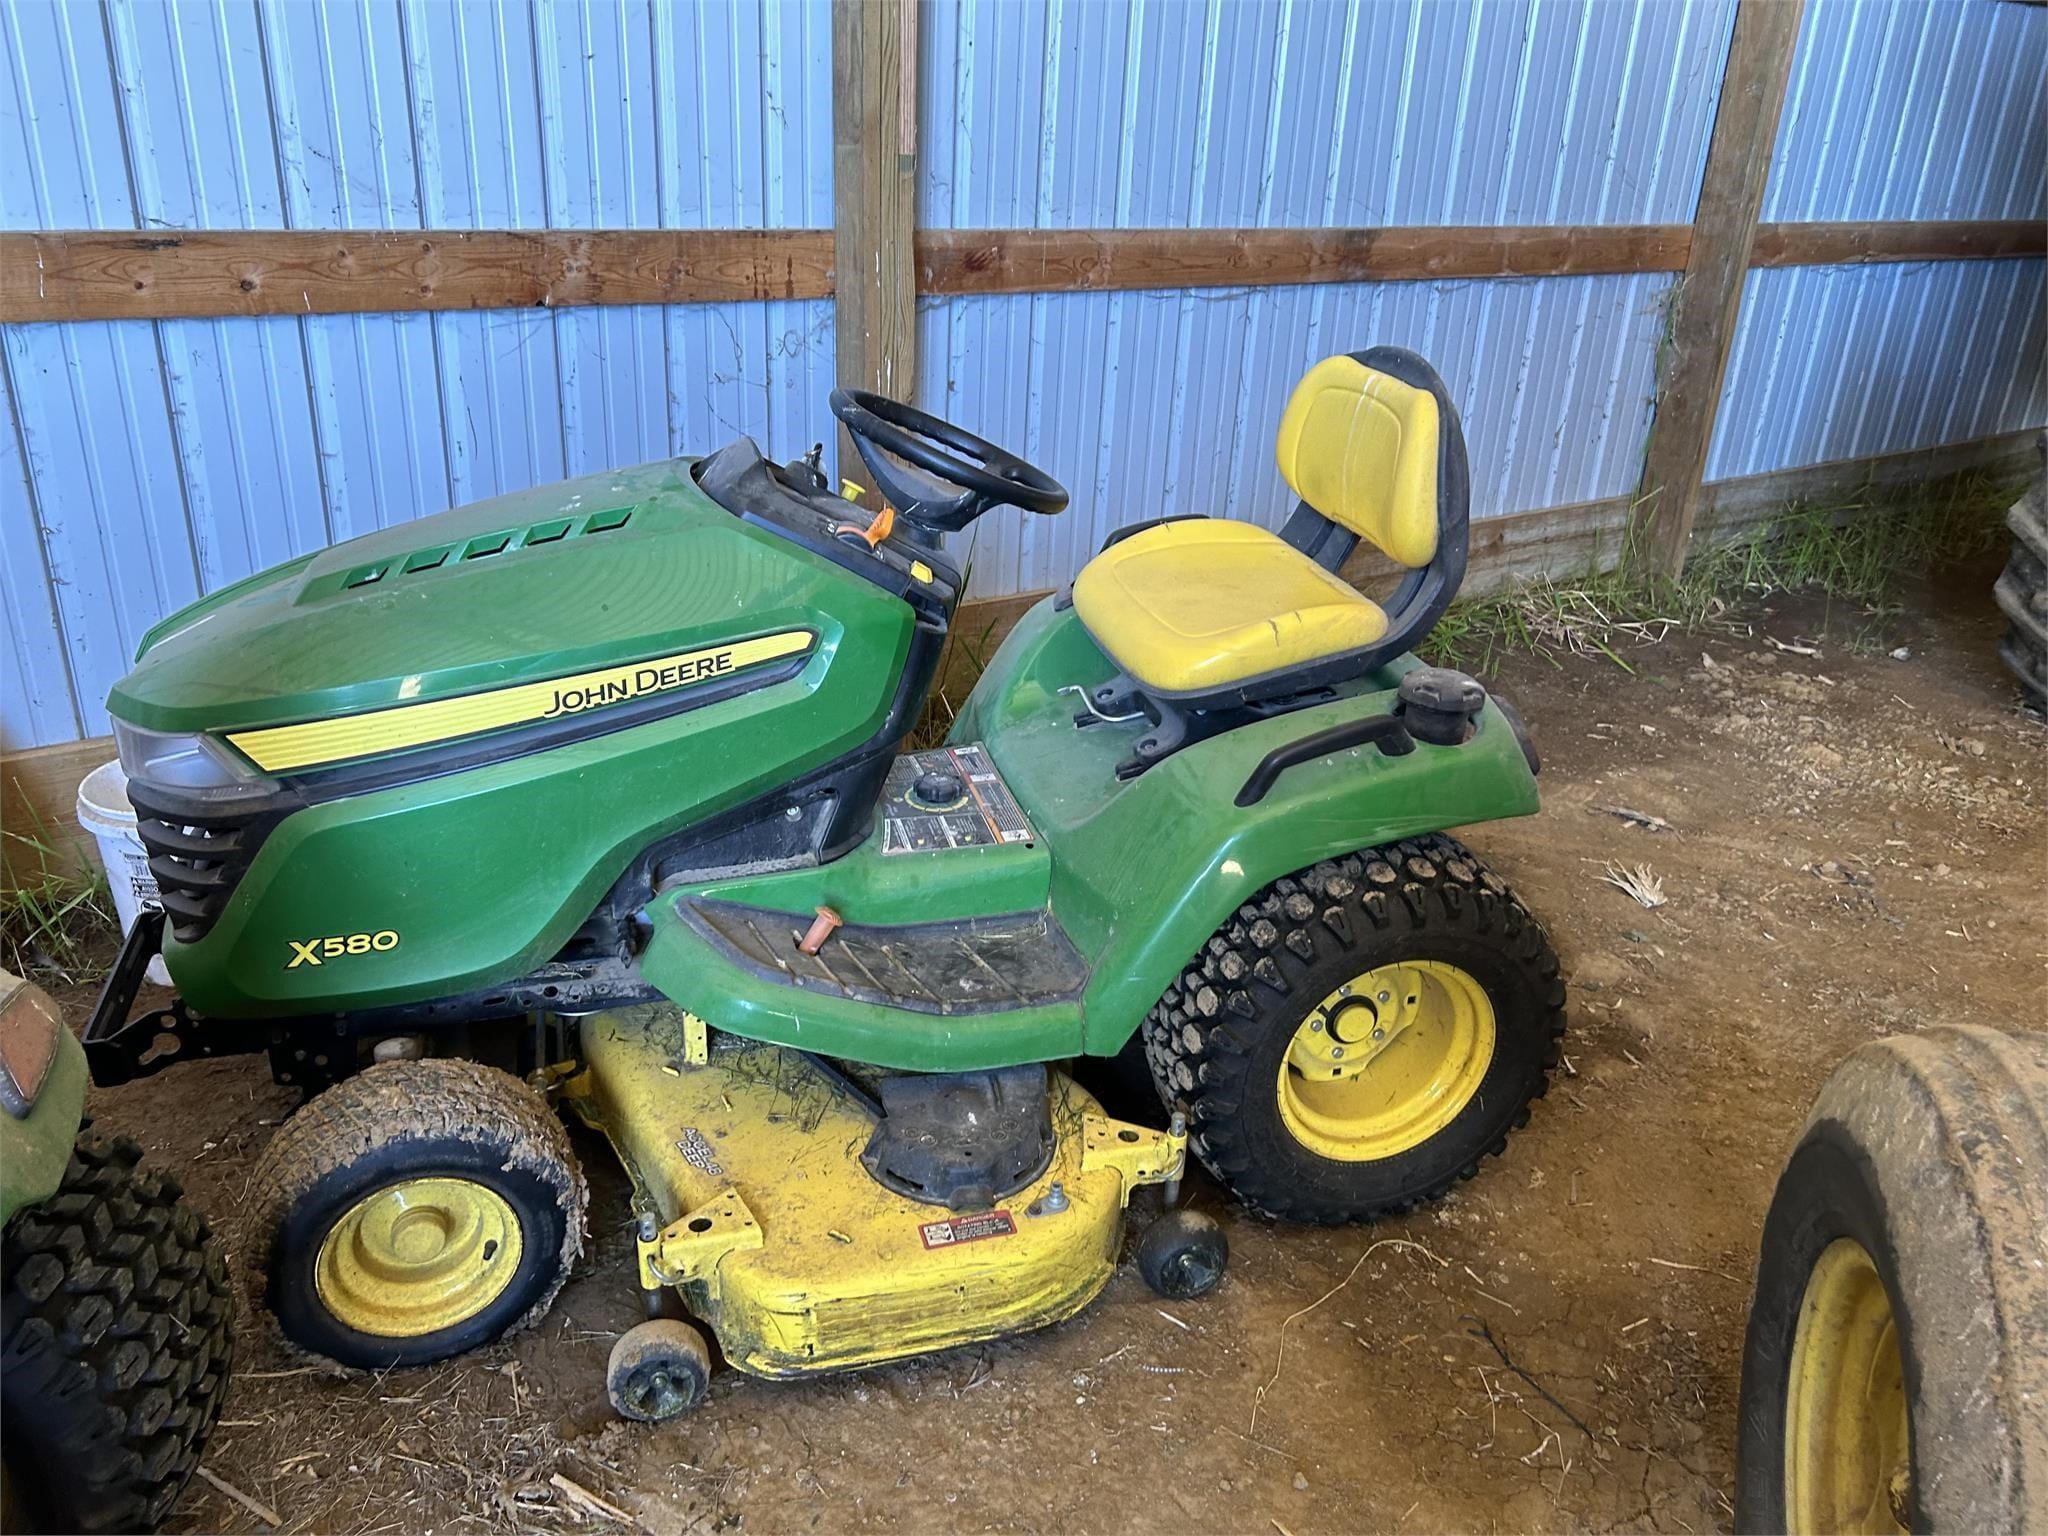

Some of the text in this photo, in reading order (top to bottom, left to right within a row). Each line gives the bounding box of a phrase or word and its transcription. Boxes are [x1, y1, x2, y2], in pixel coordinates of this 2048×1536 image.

[544, 651, 733, 715] JOHN DEERE
[284, 929, 400, 969] X580
[675, 1140, 706, 1168] DEEP
